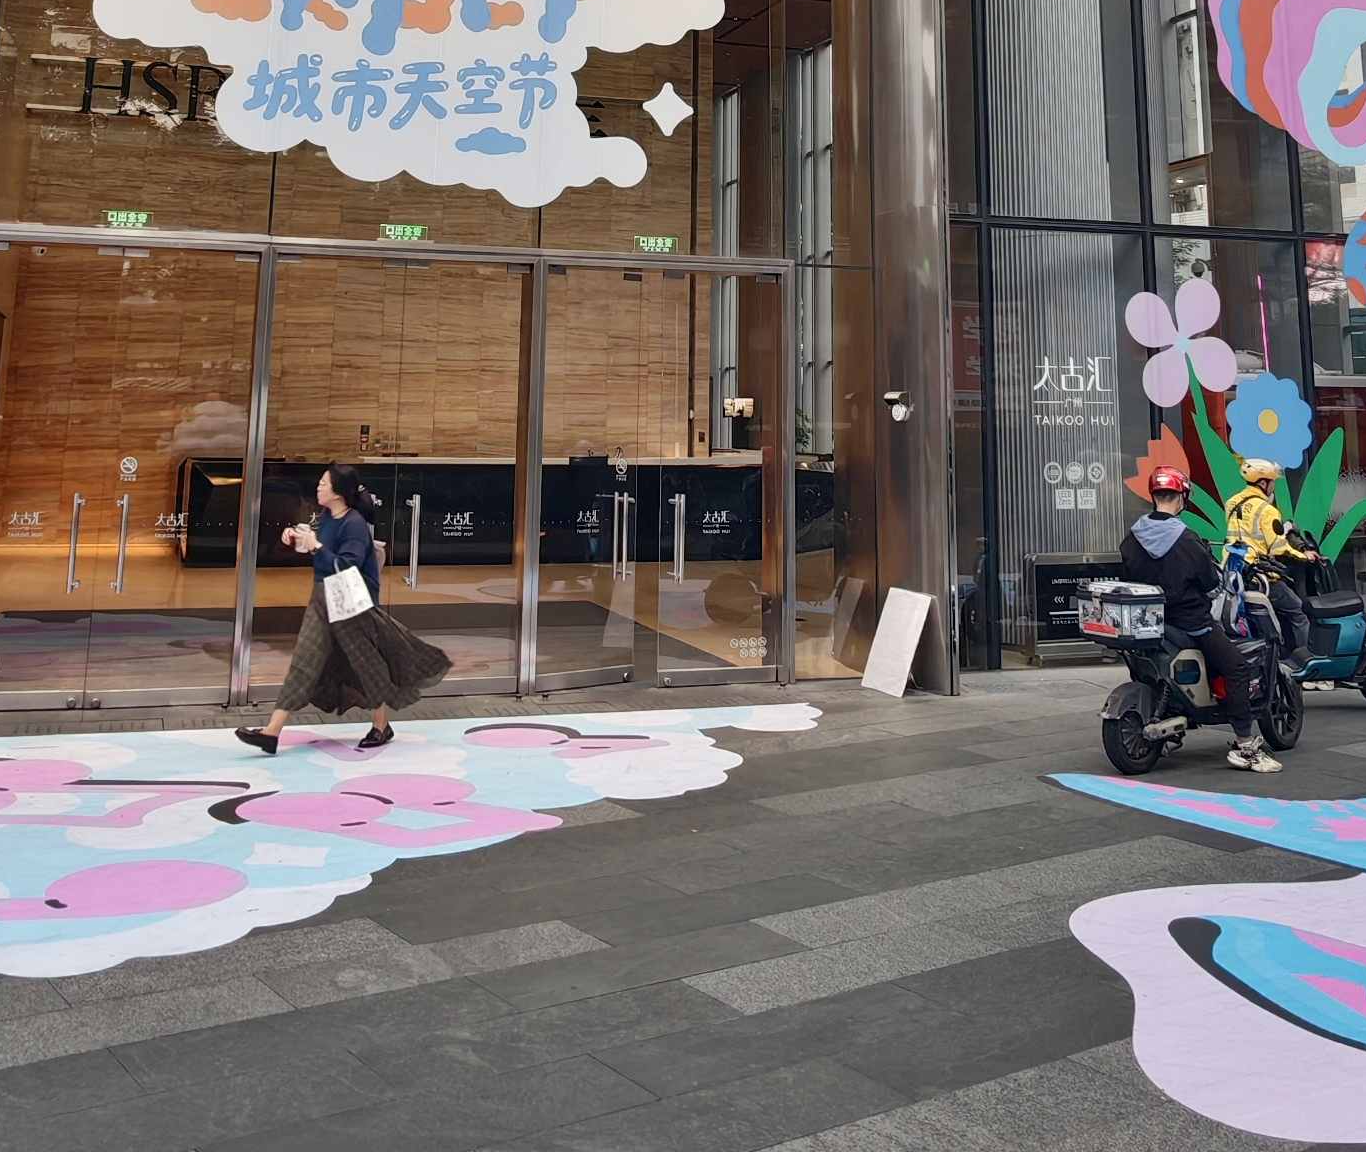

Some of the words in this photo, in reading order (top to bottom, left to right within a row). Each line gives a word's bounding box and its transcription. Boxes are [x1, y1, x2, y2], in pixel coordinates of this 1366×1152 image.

[242, 52, 558, 132] 城市天空节
[1033, 356, 1115, 392] 太古汇
[1034, 415, 1084, 426] TAIKOO
[1091, 415, 1115, 426] HUI
[155, 512, 188, 526] 太古汇
[443, 511, 474, 525] 太古汇
[703, 510, 730, 523] 太古汇
